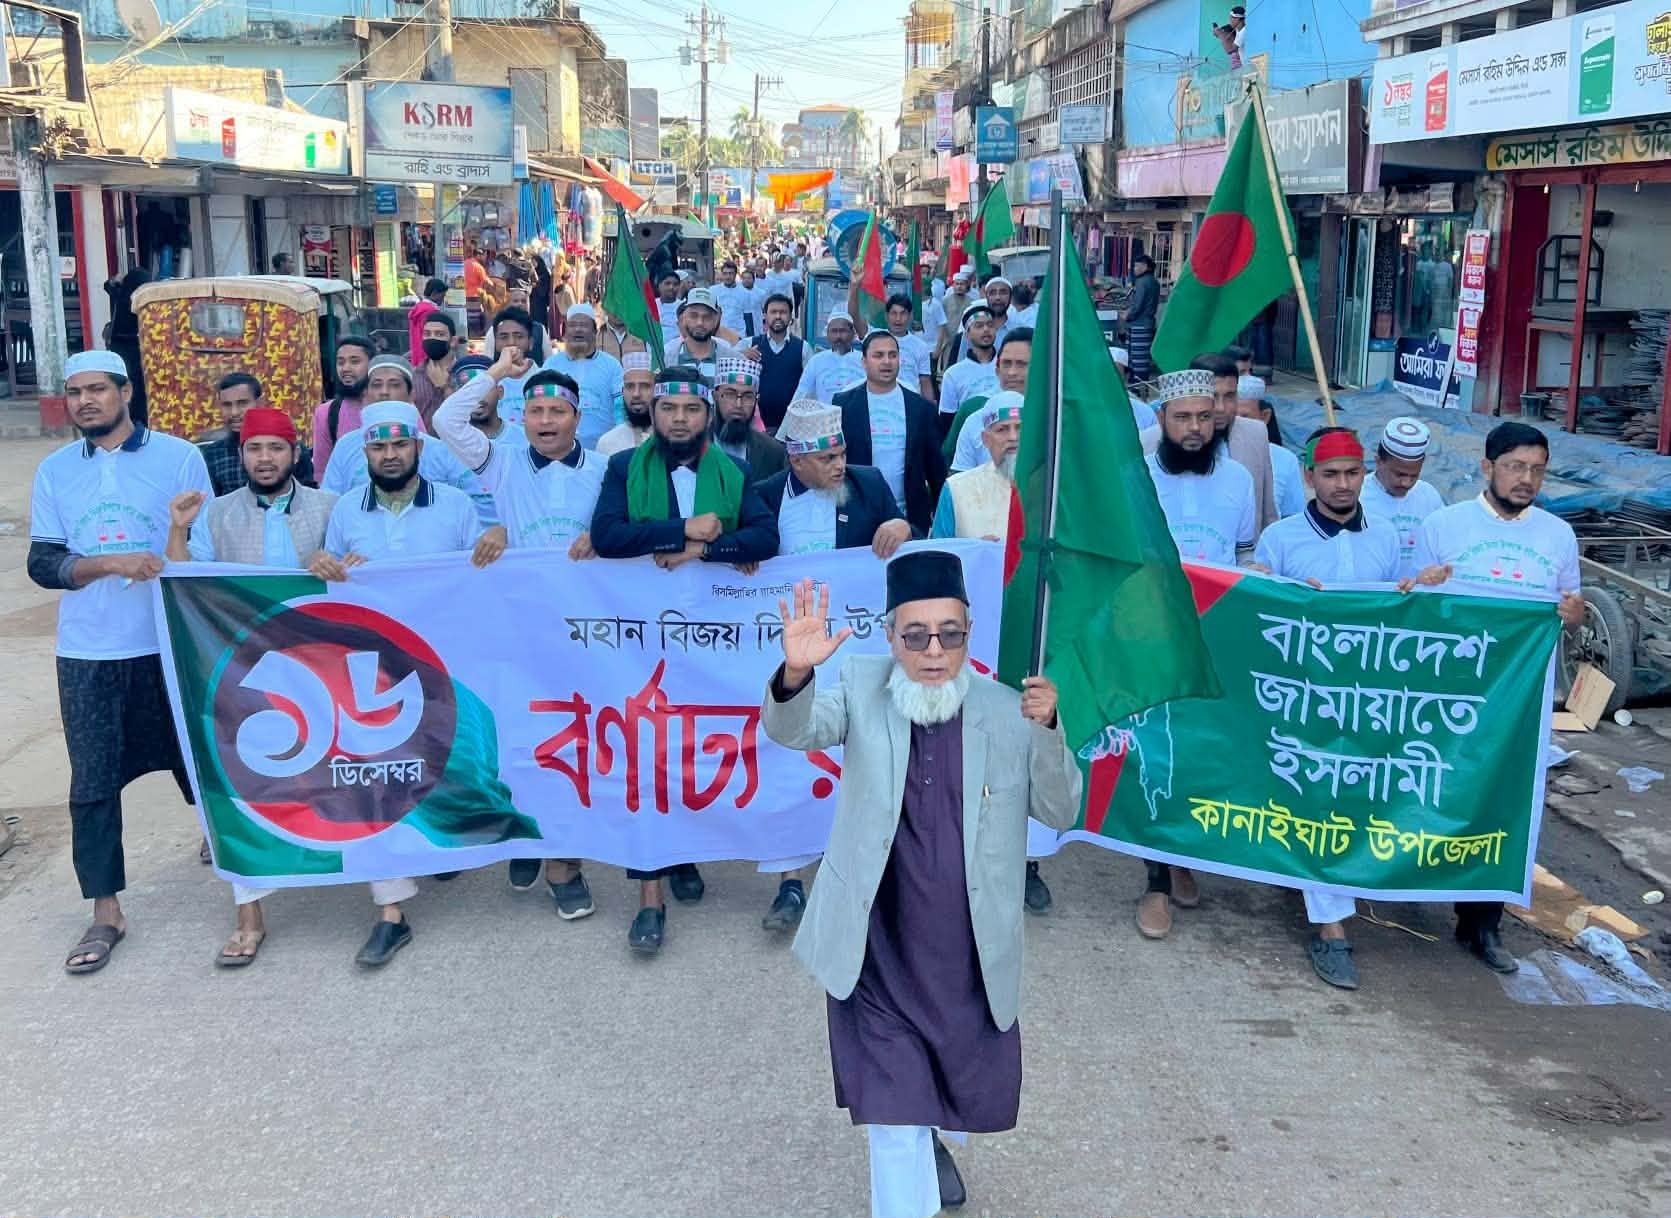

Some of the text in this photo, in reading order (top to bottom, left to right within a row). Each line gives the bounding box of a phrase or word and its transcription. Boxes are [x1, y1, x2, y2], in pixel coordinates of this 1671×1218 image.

[1483, 59, 1503, 80] রহিম
[1505, 54, 1529, 77] উদ্দিন
[404, 101, 473, 129] KSRM
[1496, 133, 1560, 166] মেসার্স
[1565, 127, 1627, 165] রহিম
[1400, 347, 1435, 380] আমিরা
[565, 616, 647, 651] মহান
[657, 610, 744, 652] বিজয়
[1257, 613, 1497, 679] বাংলাদেশ
[237, 650, 424, 778] ১৬
[1249, 670, 1487, 735] জামায়াতে
[529, 658, 761, 814] বর্ণাঢ্য
[328, 755, 425, 788] ডিসেম্বর
[1266, 727, 1453, 807] ইসলামী
[1188, 797, 1507, 866] কানাইঘাট উপজেলা
